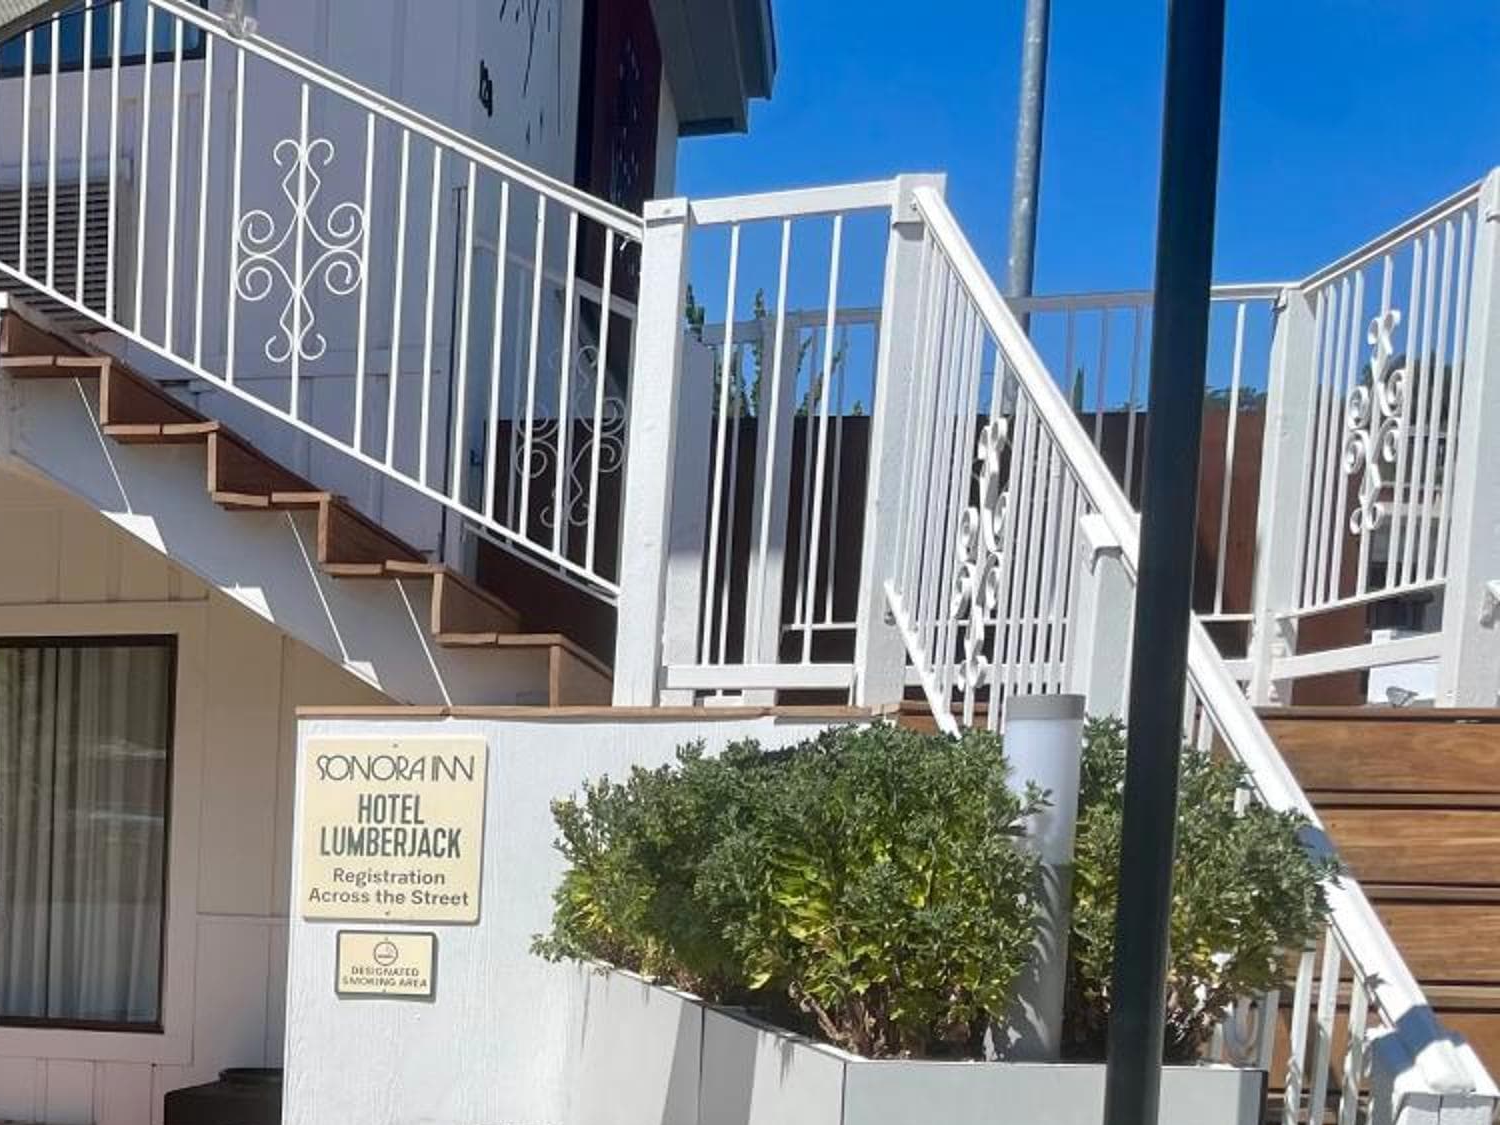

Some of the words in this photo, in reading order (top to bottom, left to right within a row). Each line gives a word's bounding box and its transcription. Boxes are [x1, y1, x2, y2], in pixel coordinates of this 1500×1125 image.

[316, 755, 424, 781] SONORA
[431, 755, 475, 781] INN
[357, 794, 424, 824] HOTEL
[320, 826, 461, 858] LUMBERJACK
[333, 867, 445, 887] Registration
[309, 887, 370, 904] Across
[376, 889, 405, 905] the
[411, 889, 468, 906] Street
[351, 966, 419, 976] DESIGNATED
[342, 976, 396, 987] SMOKING
[399, 978, 427, 987] AREA
